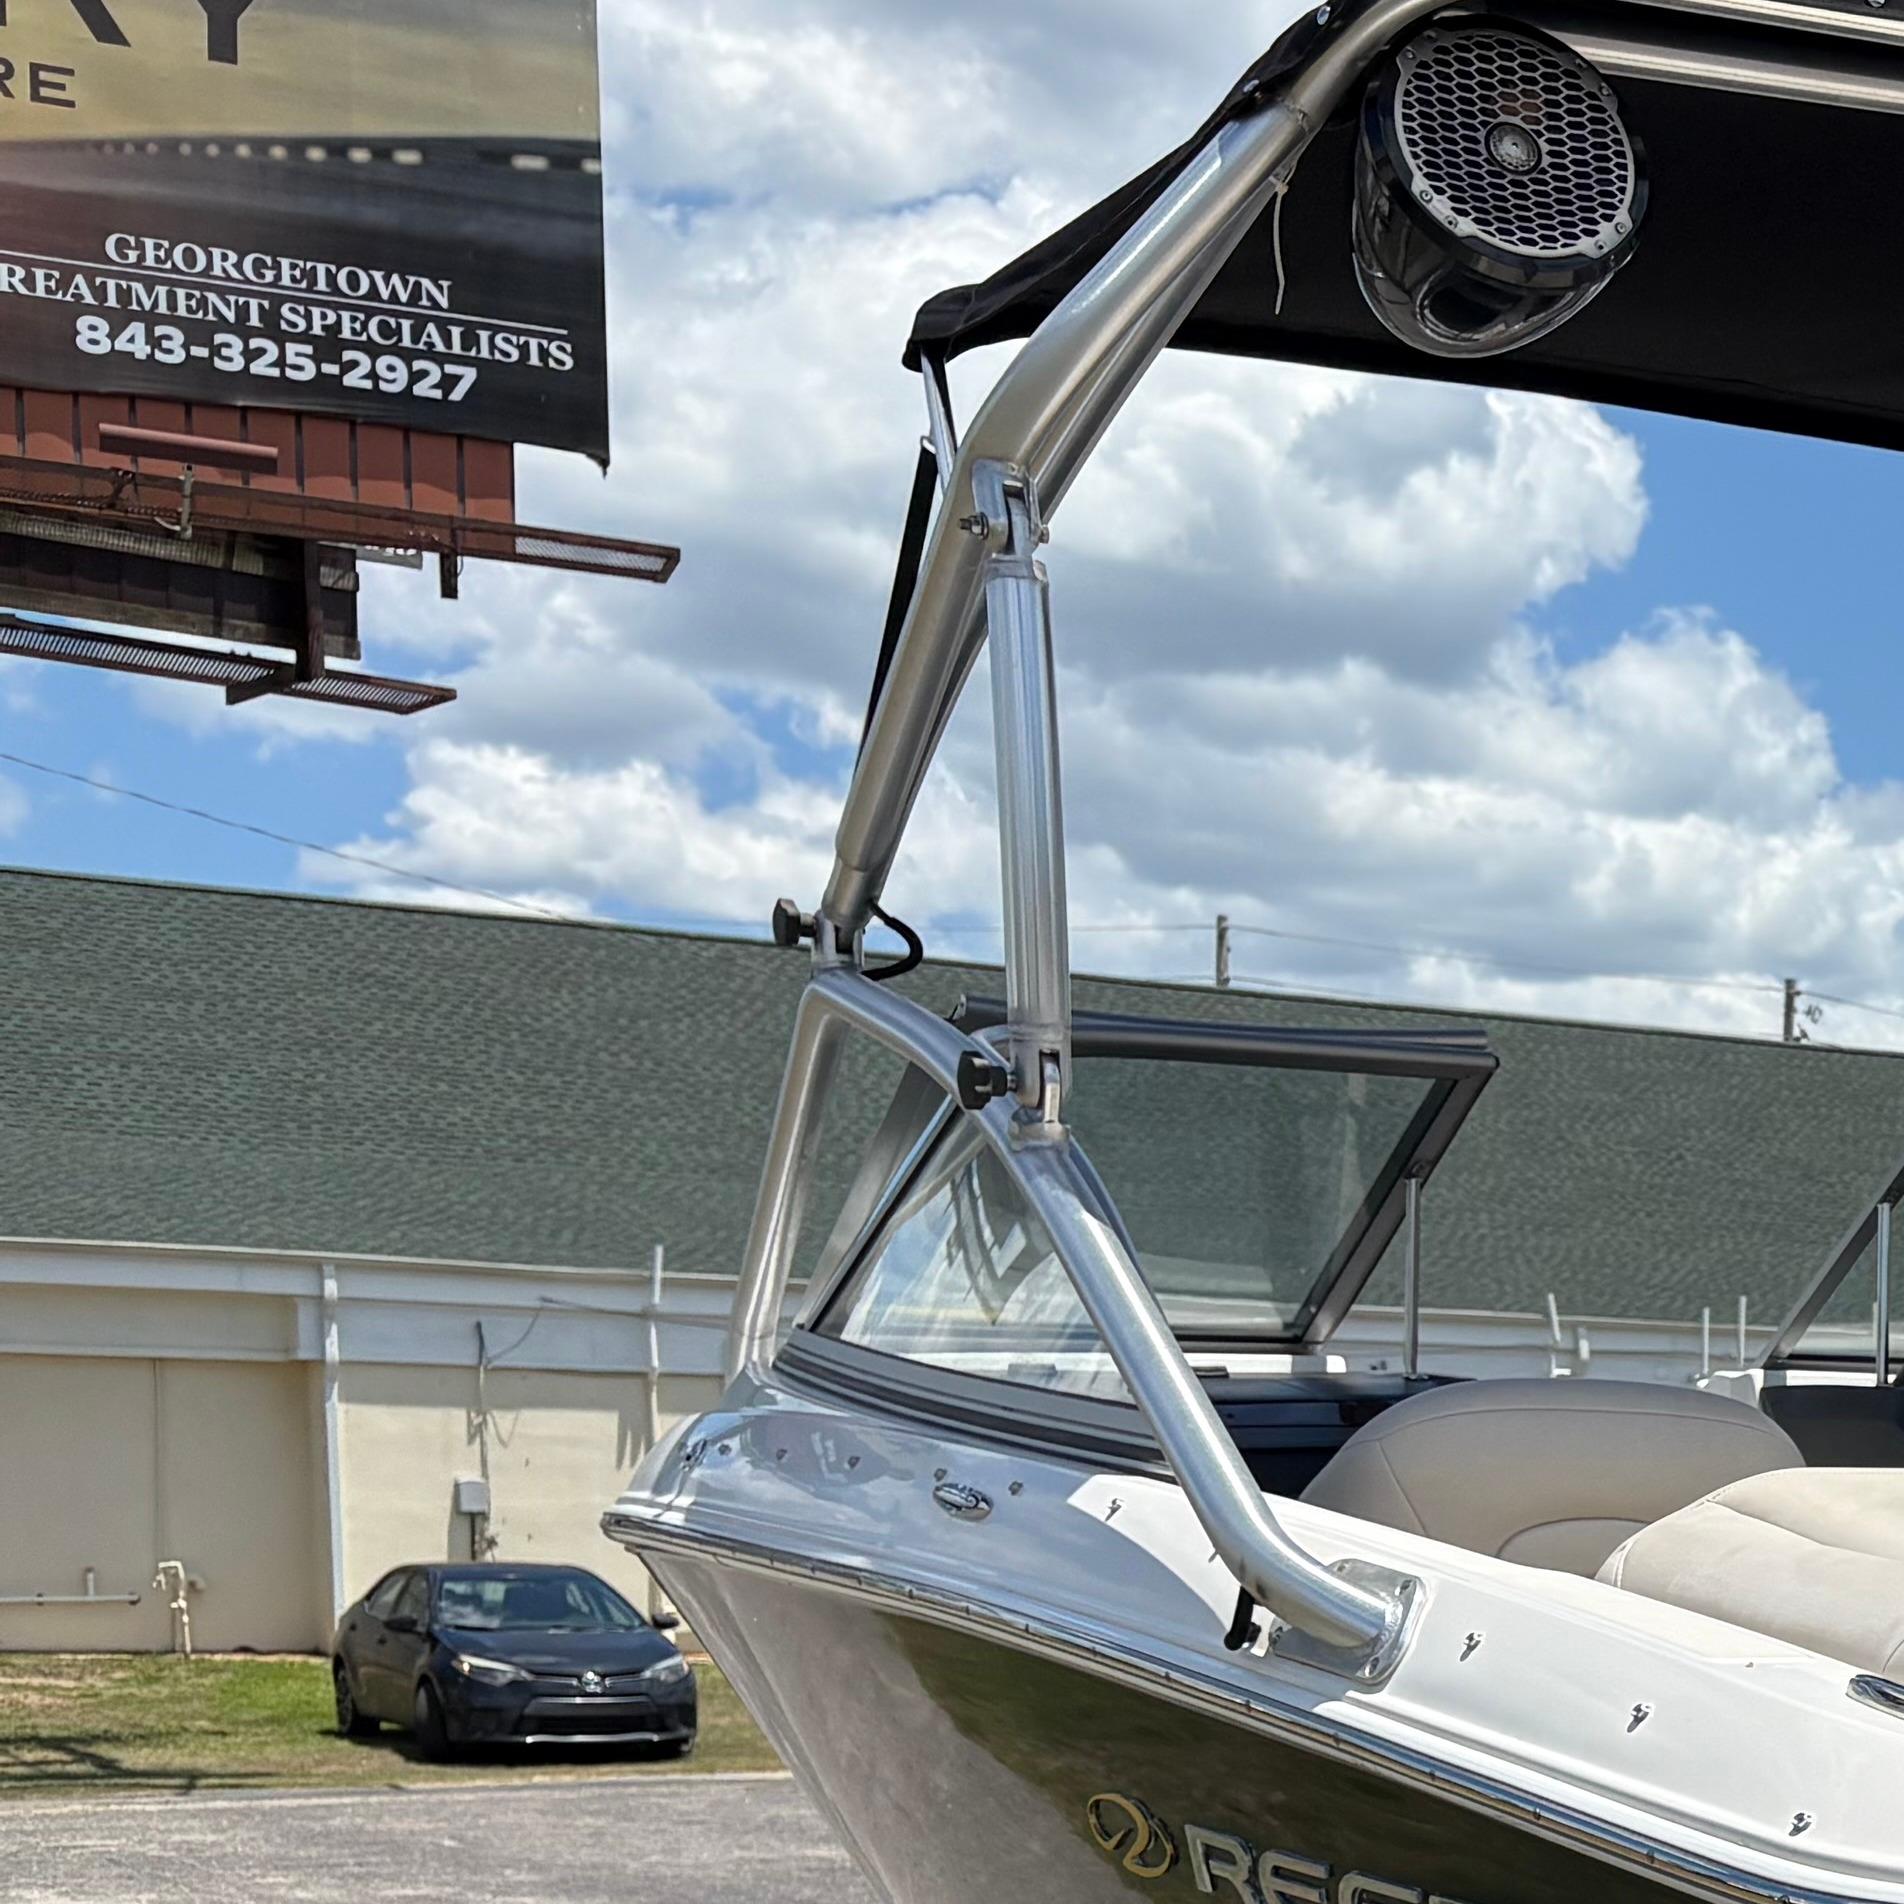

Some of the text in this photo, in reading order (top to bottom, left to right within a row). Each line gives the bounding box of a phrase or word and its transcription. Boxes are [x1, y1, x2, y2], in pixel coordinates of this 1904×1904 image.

[104, 232, 452, 311] GEORGETOWN
[0, 262, 575, 372] REATMENT SPECIALISTS
[75, 314, 478, 402] 843-325-2927
